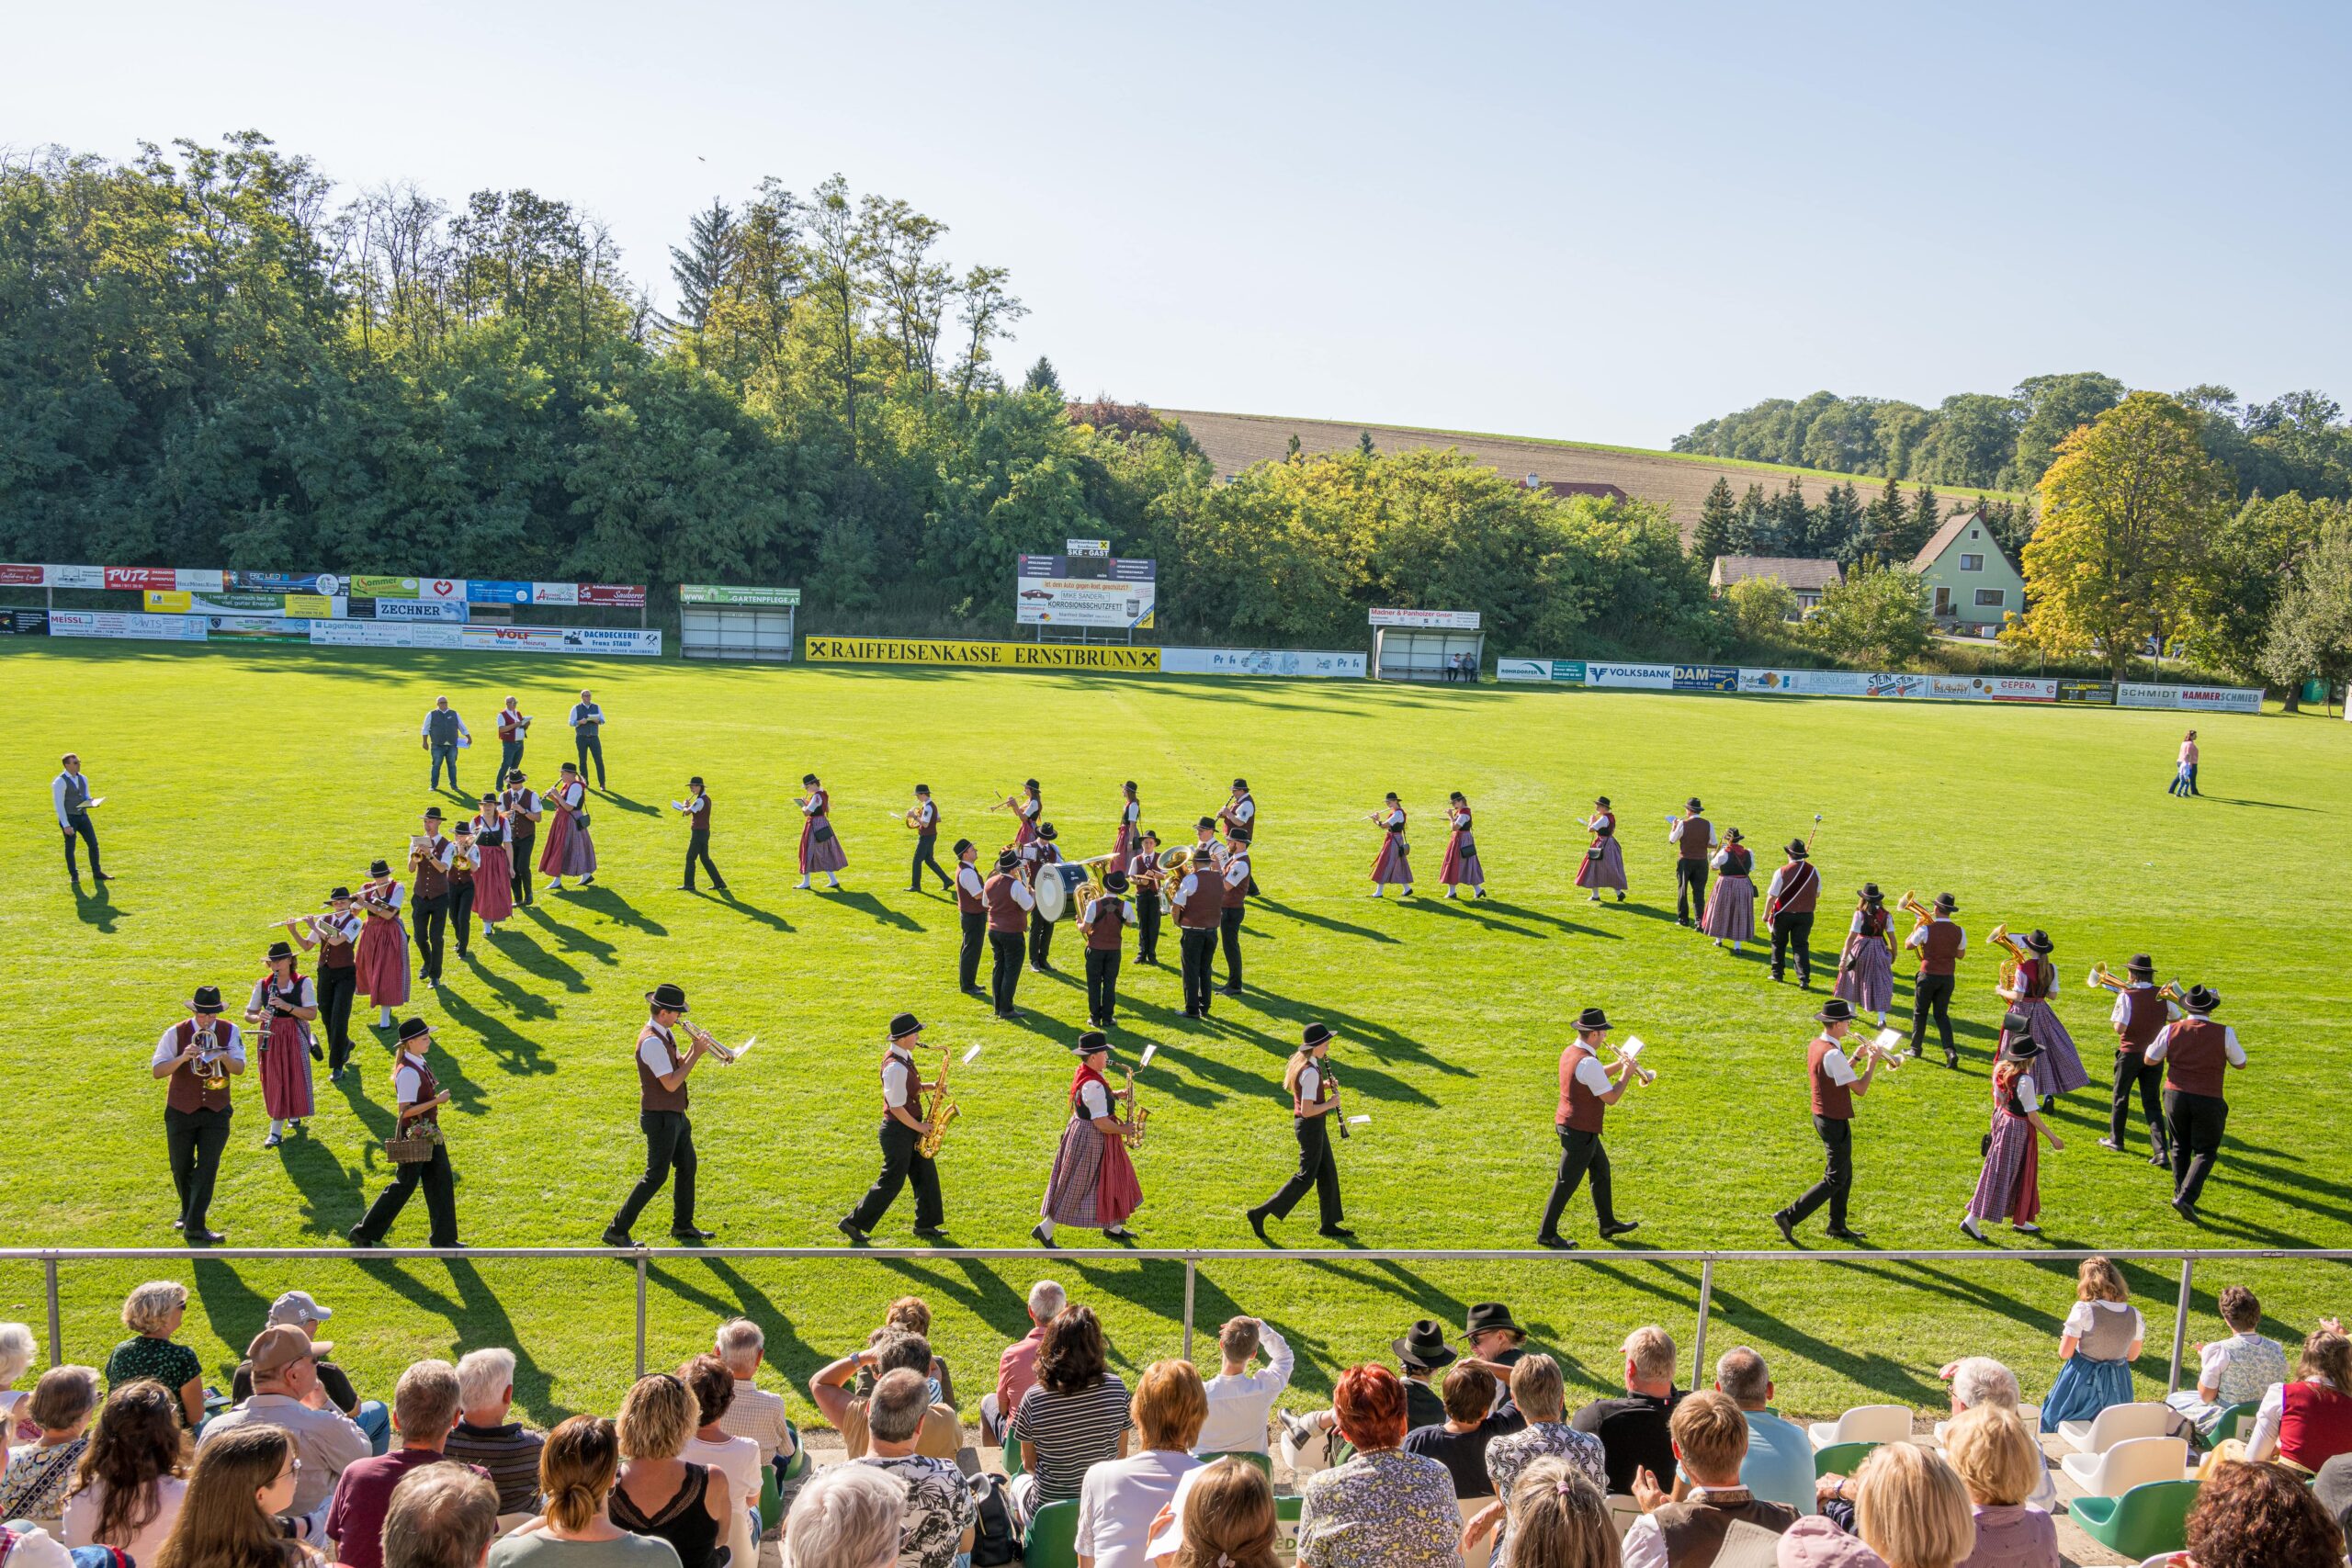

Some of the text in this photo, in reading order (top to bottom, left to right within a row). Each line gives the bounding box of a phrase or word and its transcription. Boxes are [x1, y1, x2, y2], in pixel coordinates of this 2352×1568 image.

[107, 570, 150, 582] PUTZ
[381, 604, 440, 615] ZECHNER
[1047, 601, 1123, 611] KORROSIONSSCHUTZFETT
[323, 621, 364, 630] Lagerhaus
[495, 628, 530, 639] WOLF
[584, 631, 639, 639] DACHDECKEREI
[831, 641, 1137, 667] RAIFFEISENKASSE ERNSTBRUNN
[1610, 668, 1671, 679] VOLKSBANK
[1674, 667, 1709, 681] DAM
[1867, 673, 1892, 687] STEIN
[1896, 675, 1914, 686] STEIN
[2001, 681, 2036, 690] CEPERA
[2120, 689, 2177, 699] SCHMIDT
[2182, 691, 2258, 703] HAMMERSCHMIED
